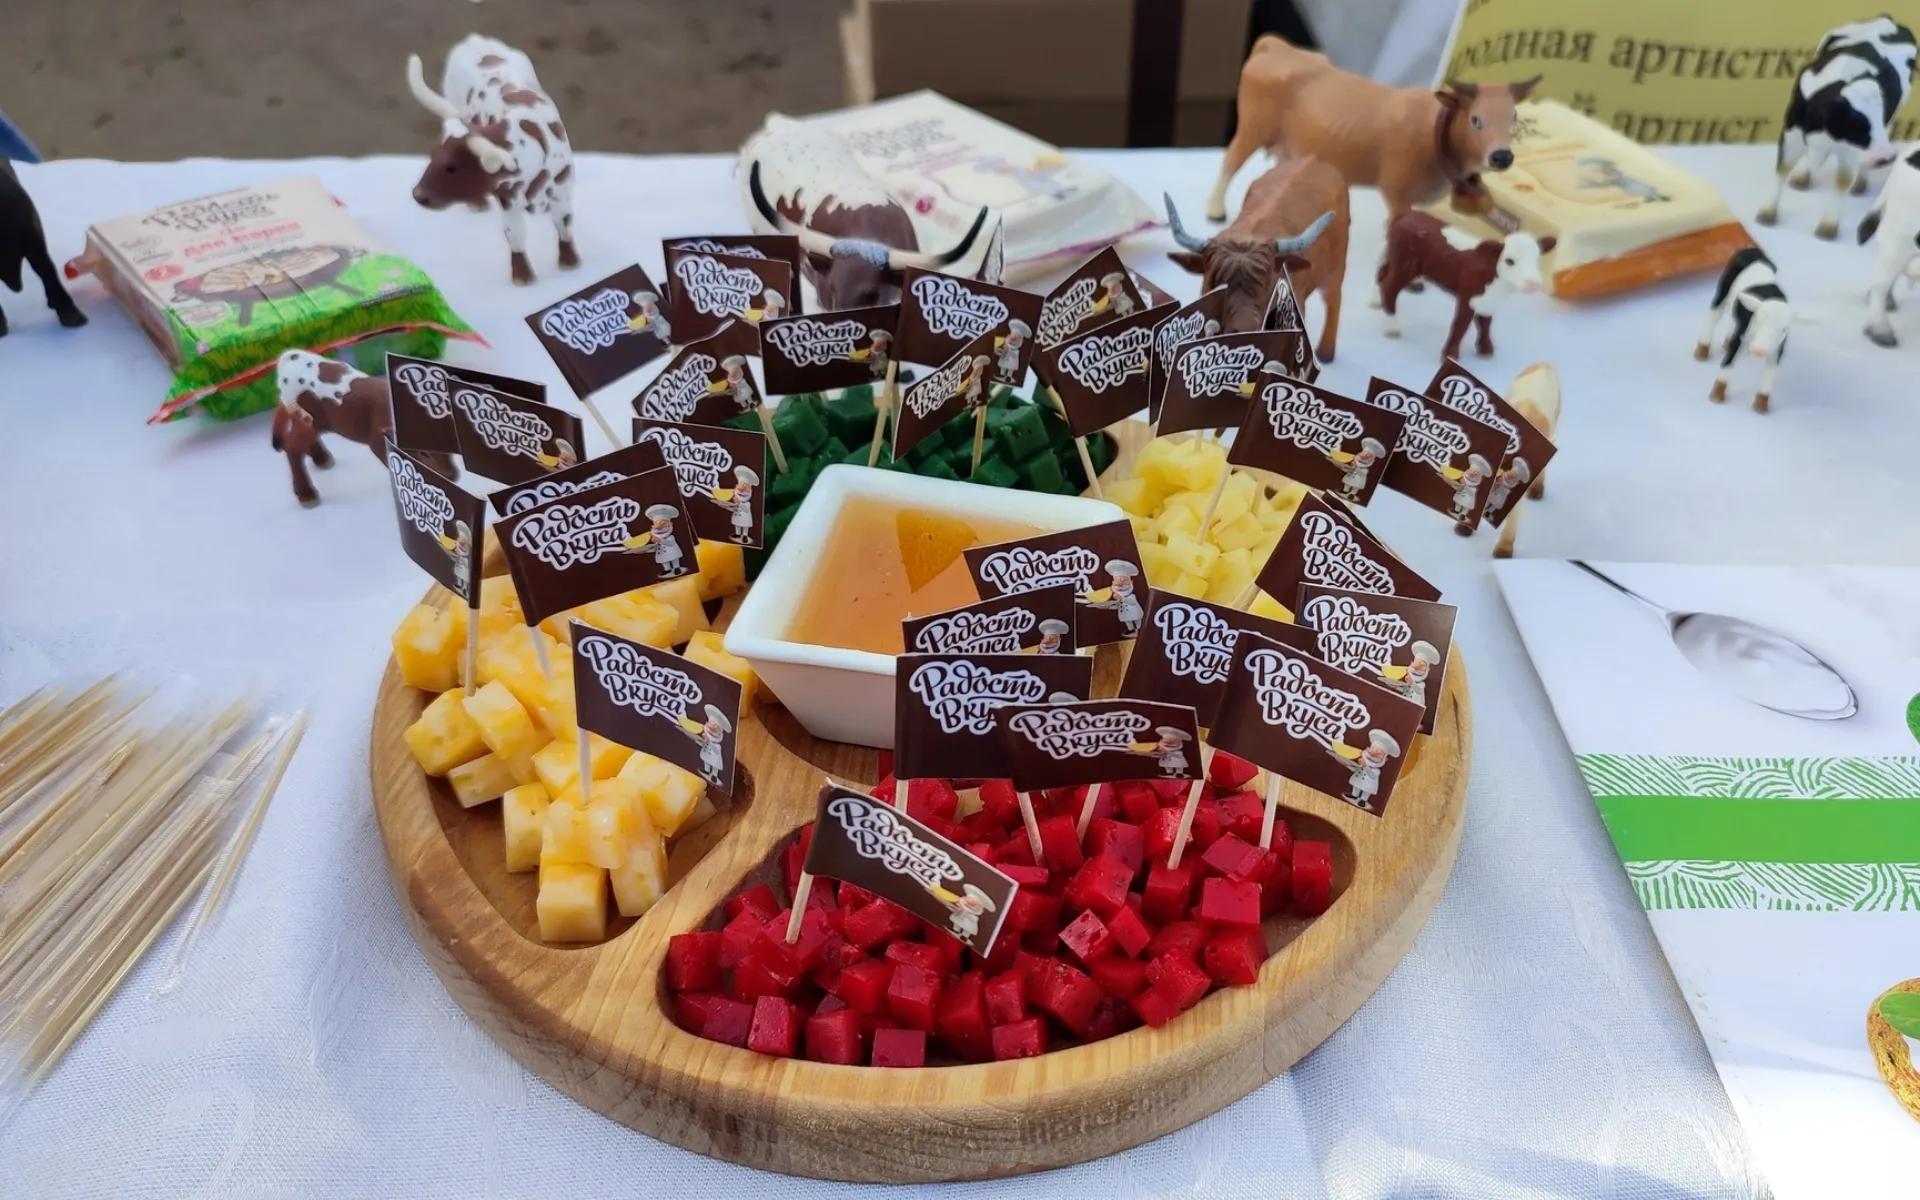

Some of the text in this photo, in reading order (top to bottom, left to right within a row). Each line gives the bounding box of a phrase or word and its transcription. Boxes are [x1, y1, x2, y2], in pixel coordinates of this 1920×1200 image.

[678, 258, 761, 292] Радость
[545, 289, 628, 339] Радость
[692, 284, 747, 315] Вкуса
[912, 278, 1007, 319] Радость
[571, 311, 628, 353] Вкуса
[767, 320, 866, 349] Радость
[926, 306, 992, 338] Вкуса
[1042, 300, 1093, 342] Вкуса
[789, 341, 856, 366] Вкуса
[1059, 327, 1151, 374] Радость
[1083, 348, 1146, 391] Вкуса
[1179, 344, 1262, 377] Радость
[645, 356, 717, 418] Радость
[664, 376, 709, 421] Вкуса
[1187, 366, 1246, 395] Вкуса
[458, 391, 551, 439] Радость
[1264, 384, 1361, 440] Радость
[1272, 412, 1340, 451] Вкуса
[1378, 392, 1468, 451] Рдость
[478, 420, 543, 456] Вкуса
[392, 453, 454, 520] Радость
[677, 464, 717, 493] куса
[402, 492, 444, 532] Вкуса
[514, 500, 638, 551] Радость
[543, 525, 631, 570] Вкуса
[1303, 513, 1393, 595] Радость
[983, 548, 1098, 590] Радость
[918, 608, 1035, 655] Радость
[1156, 605, 1240, 645] Радос
[1306, 597, 1408, 645] Радость
[580, 638, 701, 704] Радость
[1168, 642, 1234, 681] Вкус
[1318, 631, 1392, 674] Вкуса
[602, 673, 686, 715] Вкуса
[911, 661, 1044, 704] Радость
[1246, 650, 1368, 726] Радость
[932, 696, 996, 734] Вку
[1011, 712, 1151, 740] Радость
[1260, 690, 1344, 745] Вкуса
[1040, 730, 1137, 758] Вкуса
[832, 799, 961, 880] Радость
[851, 828, 942, 889] Вкуса
